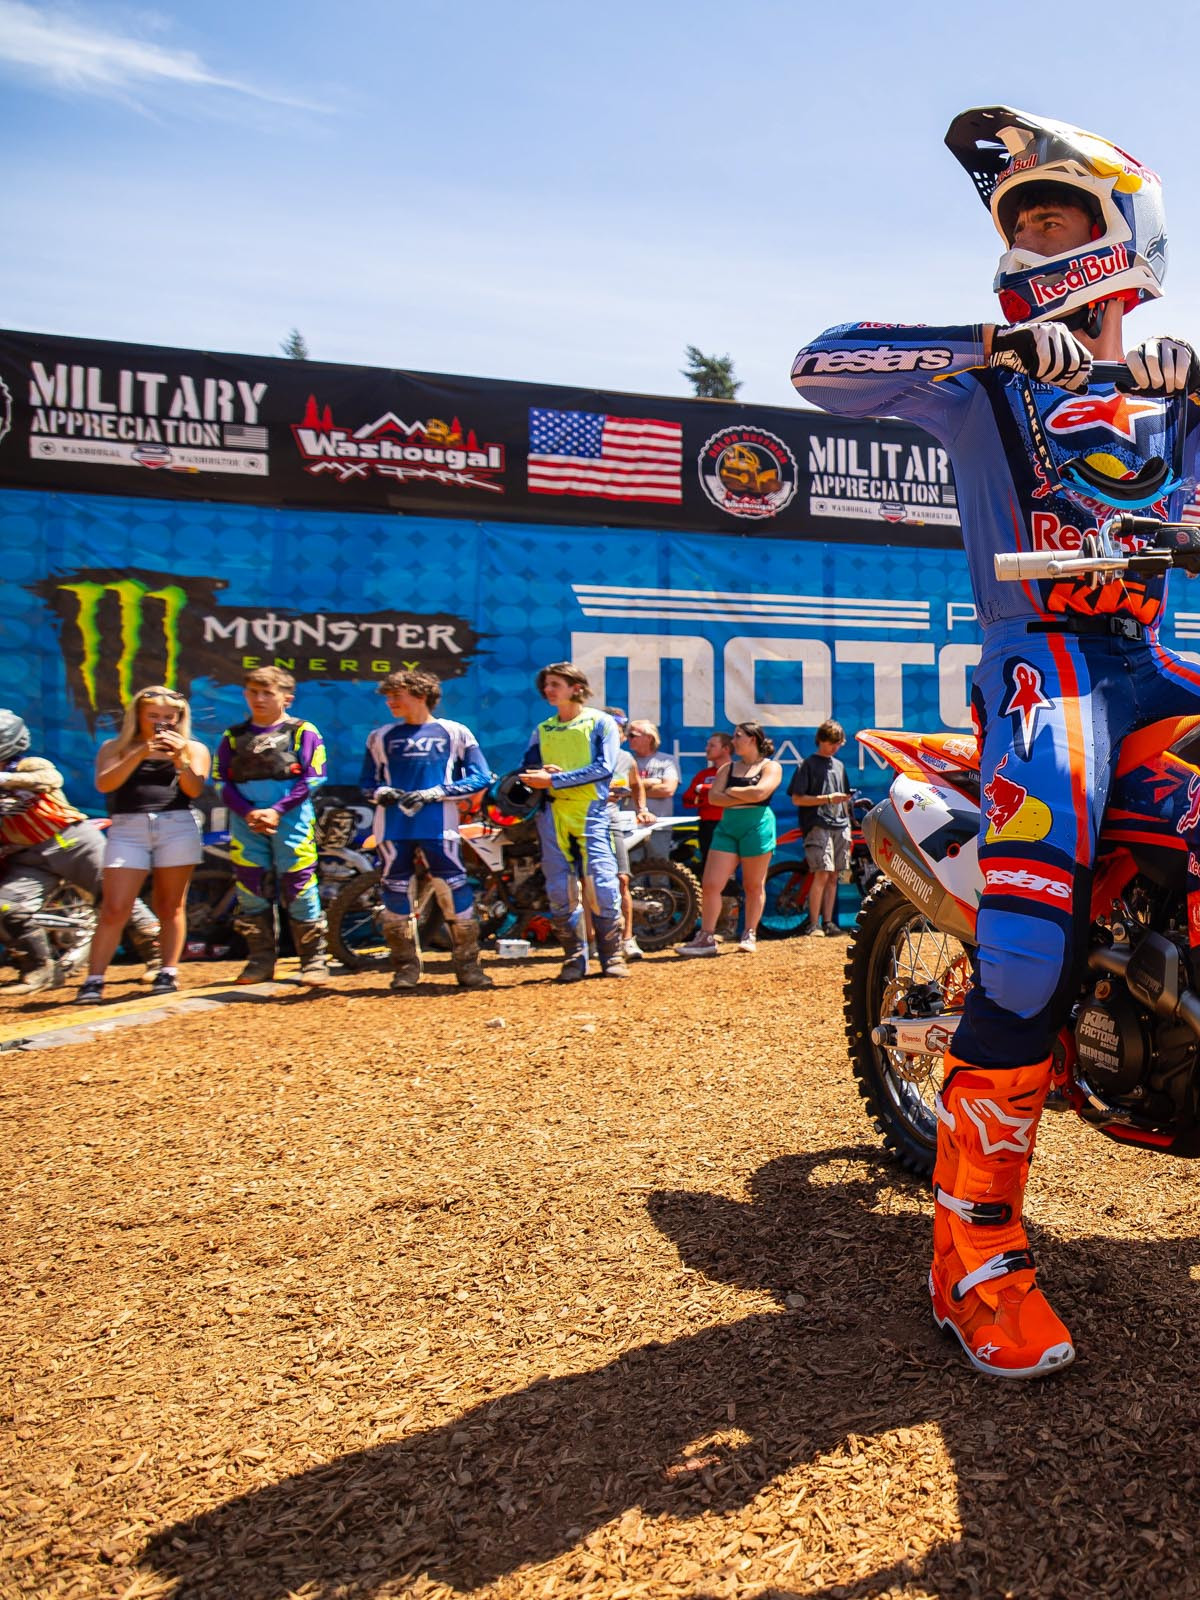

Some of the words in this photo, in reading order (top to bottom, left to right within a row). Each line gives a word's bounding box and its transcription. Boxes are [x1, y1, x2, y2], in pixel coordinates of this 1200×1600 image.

[1013, 154, 1038, 171] Bull
[1029, 256, 1086, 306] Red
[1083, 243, 1130, 283] Bull
[29, 361, 268, 425] MILITARY
[31, 408, 221, 447] APPRECIATION
[1023, 389, 1053, 470] OAKLEY
[297, 428, 501, 469] Washougal
[809, 435, 949, 484] MILITAR
[810, 474, 939, 504] APPRECIATION
[1031, 511, 1104, 551] Re
[203, 613, 464, 654] MONSTER
[242, 656, 422, 673] ENERGY
[388, 737, 447, 753] FXR
[890, 853, 934, 904] AKRAPOVIČ
[1080, 1024, 1119, 1046] FACTORY
[1084, 1011, 1115, 1033] KTM
[1080, 1043, 1119, 1067] HINSON
